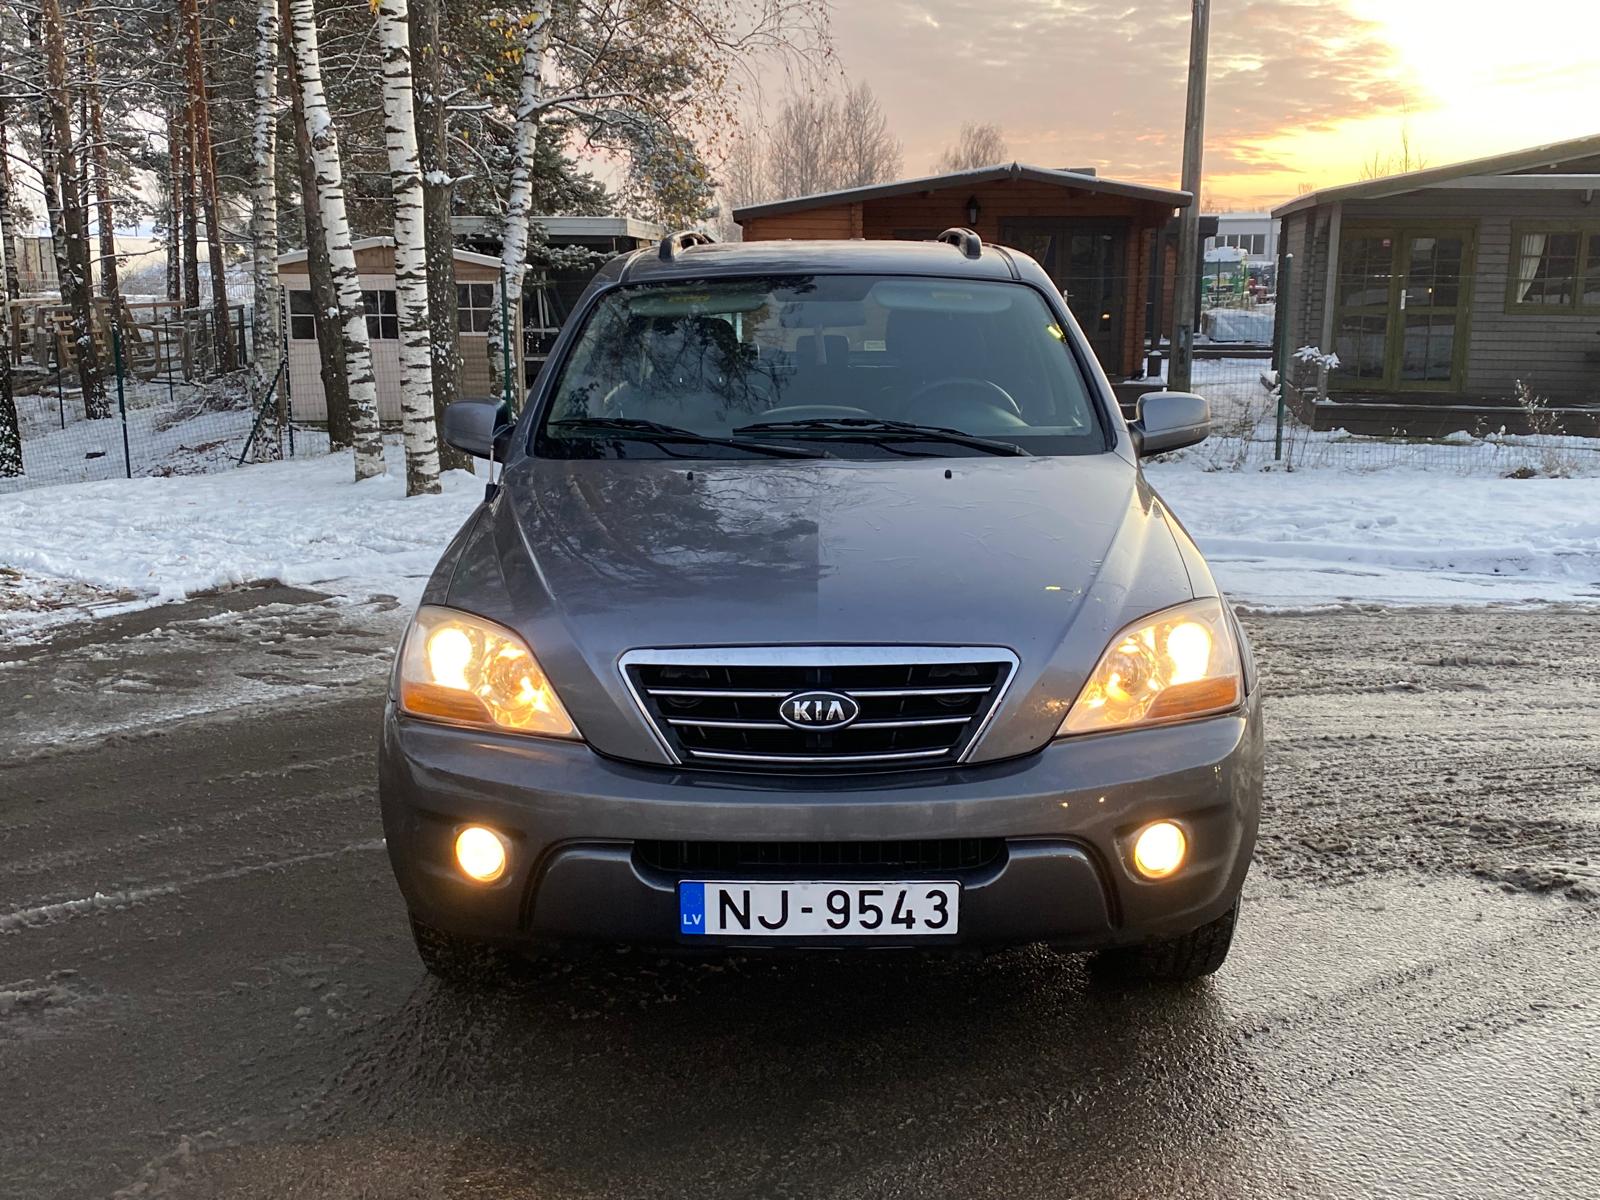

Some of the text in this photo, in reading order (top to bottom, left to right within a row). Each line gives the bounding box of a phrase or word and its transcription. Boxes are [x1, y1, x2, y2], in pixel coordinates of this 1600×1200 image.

[793, 700, 846, 721] KIA
[683, 913, 702, 926] LV
[718, 889, 950, 930] NJ-9543
